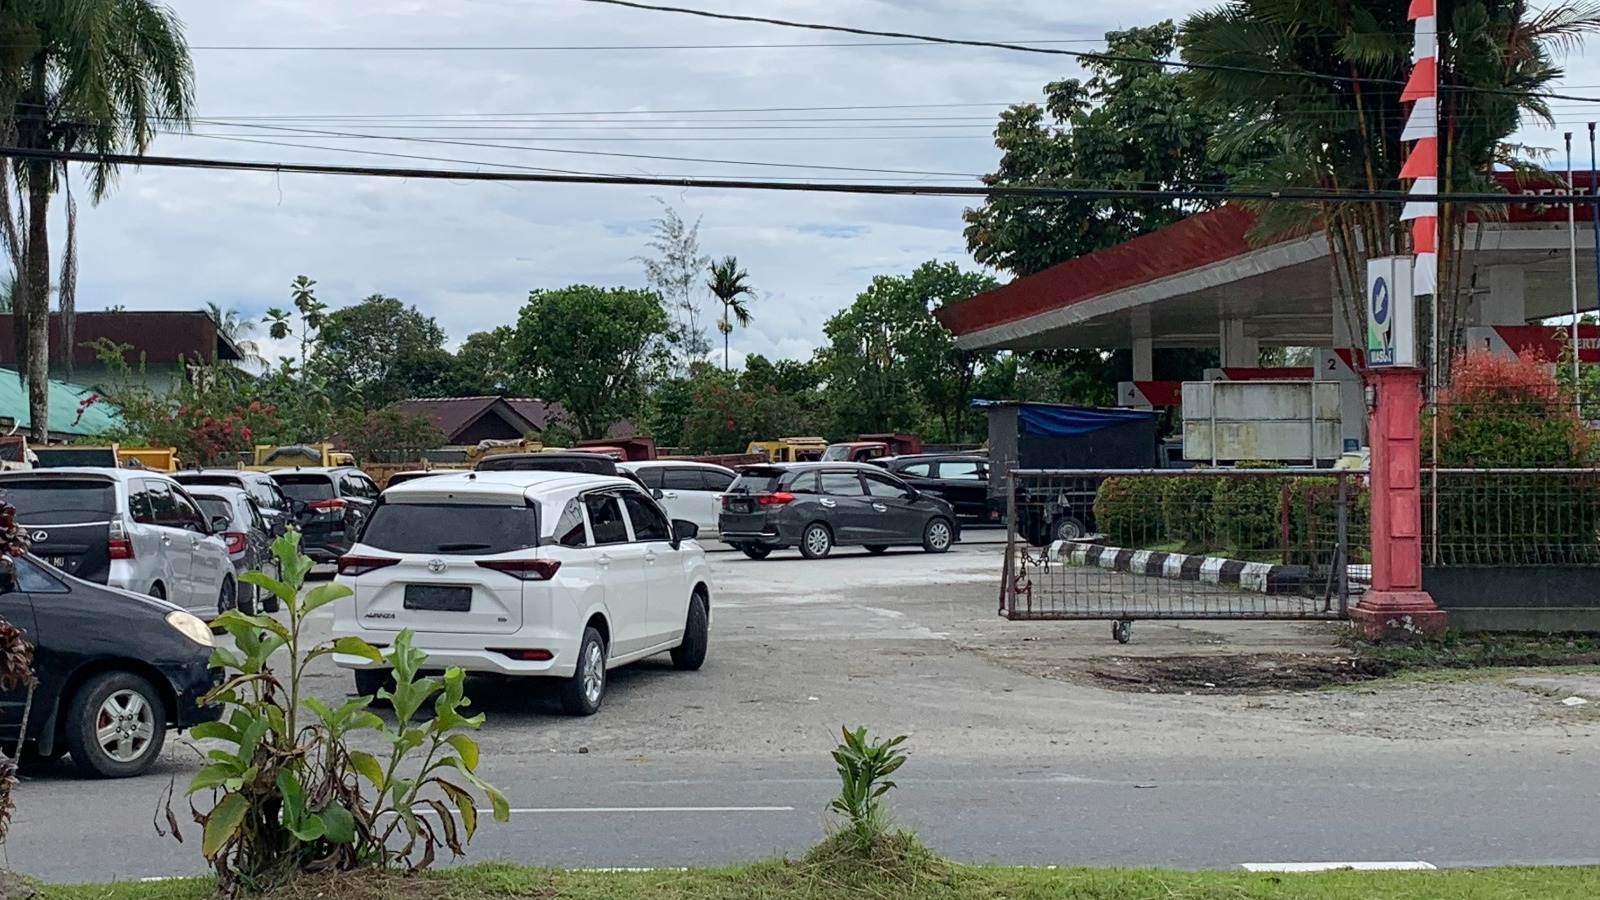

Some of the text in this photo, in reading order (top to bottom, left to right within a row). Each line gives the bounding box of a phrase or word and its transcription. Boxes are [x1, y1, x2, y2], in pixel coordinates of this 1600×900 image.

[1523, 187, 1600, 208] PERT
[1327, 358, 1336, 370] 2
[1127, 389, 1135, 398] 4
